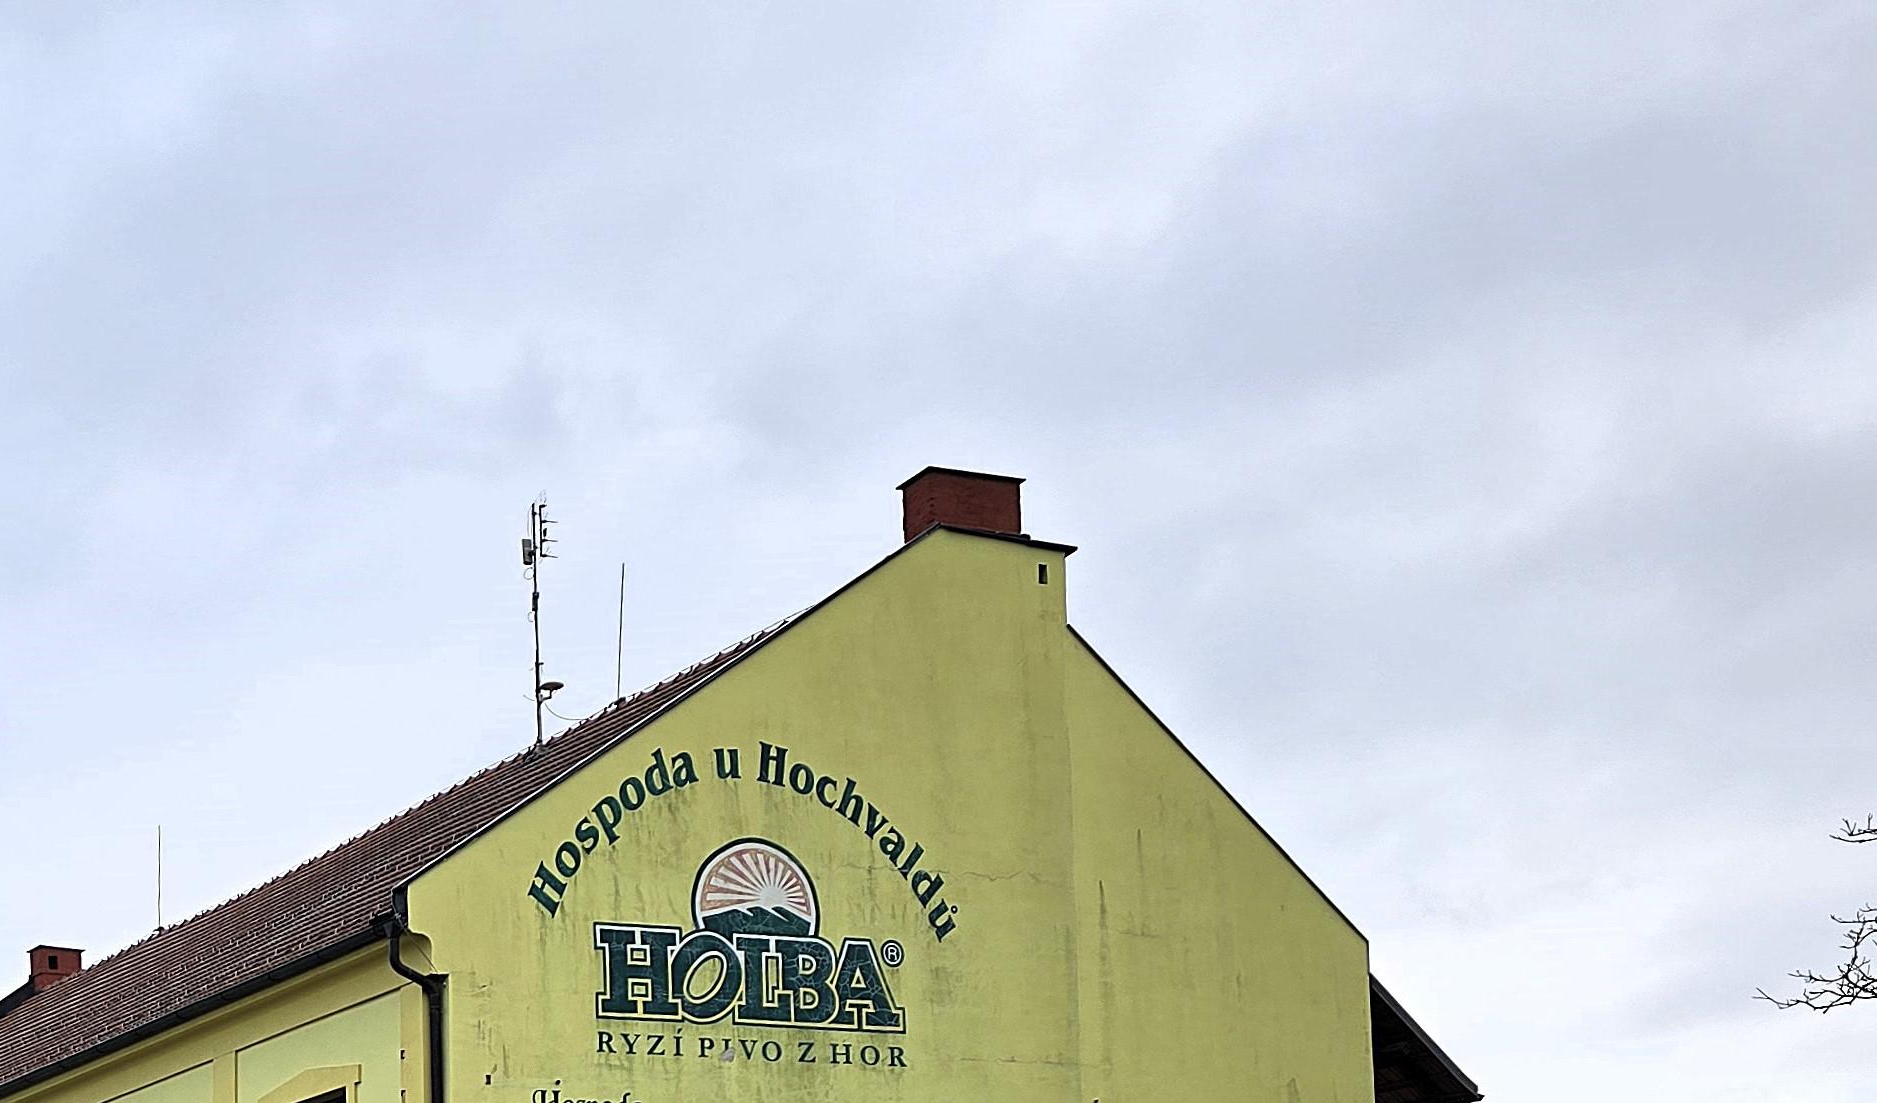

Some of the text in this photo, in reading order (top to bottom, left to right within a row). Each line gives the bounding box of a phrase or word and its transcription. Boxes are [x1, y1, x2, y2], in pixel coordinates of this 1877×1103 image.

[528, 741, 959, 943] Hospoda u Hochvaldů
[593, 921, 907, 1034] HOLBA
[596, 1027, 684, 1057] RYZÍ
[797, 1041, 817, 1064] Z
[829, 1042, 908, 1068] HOR
